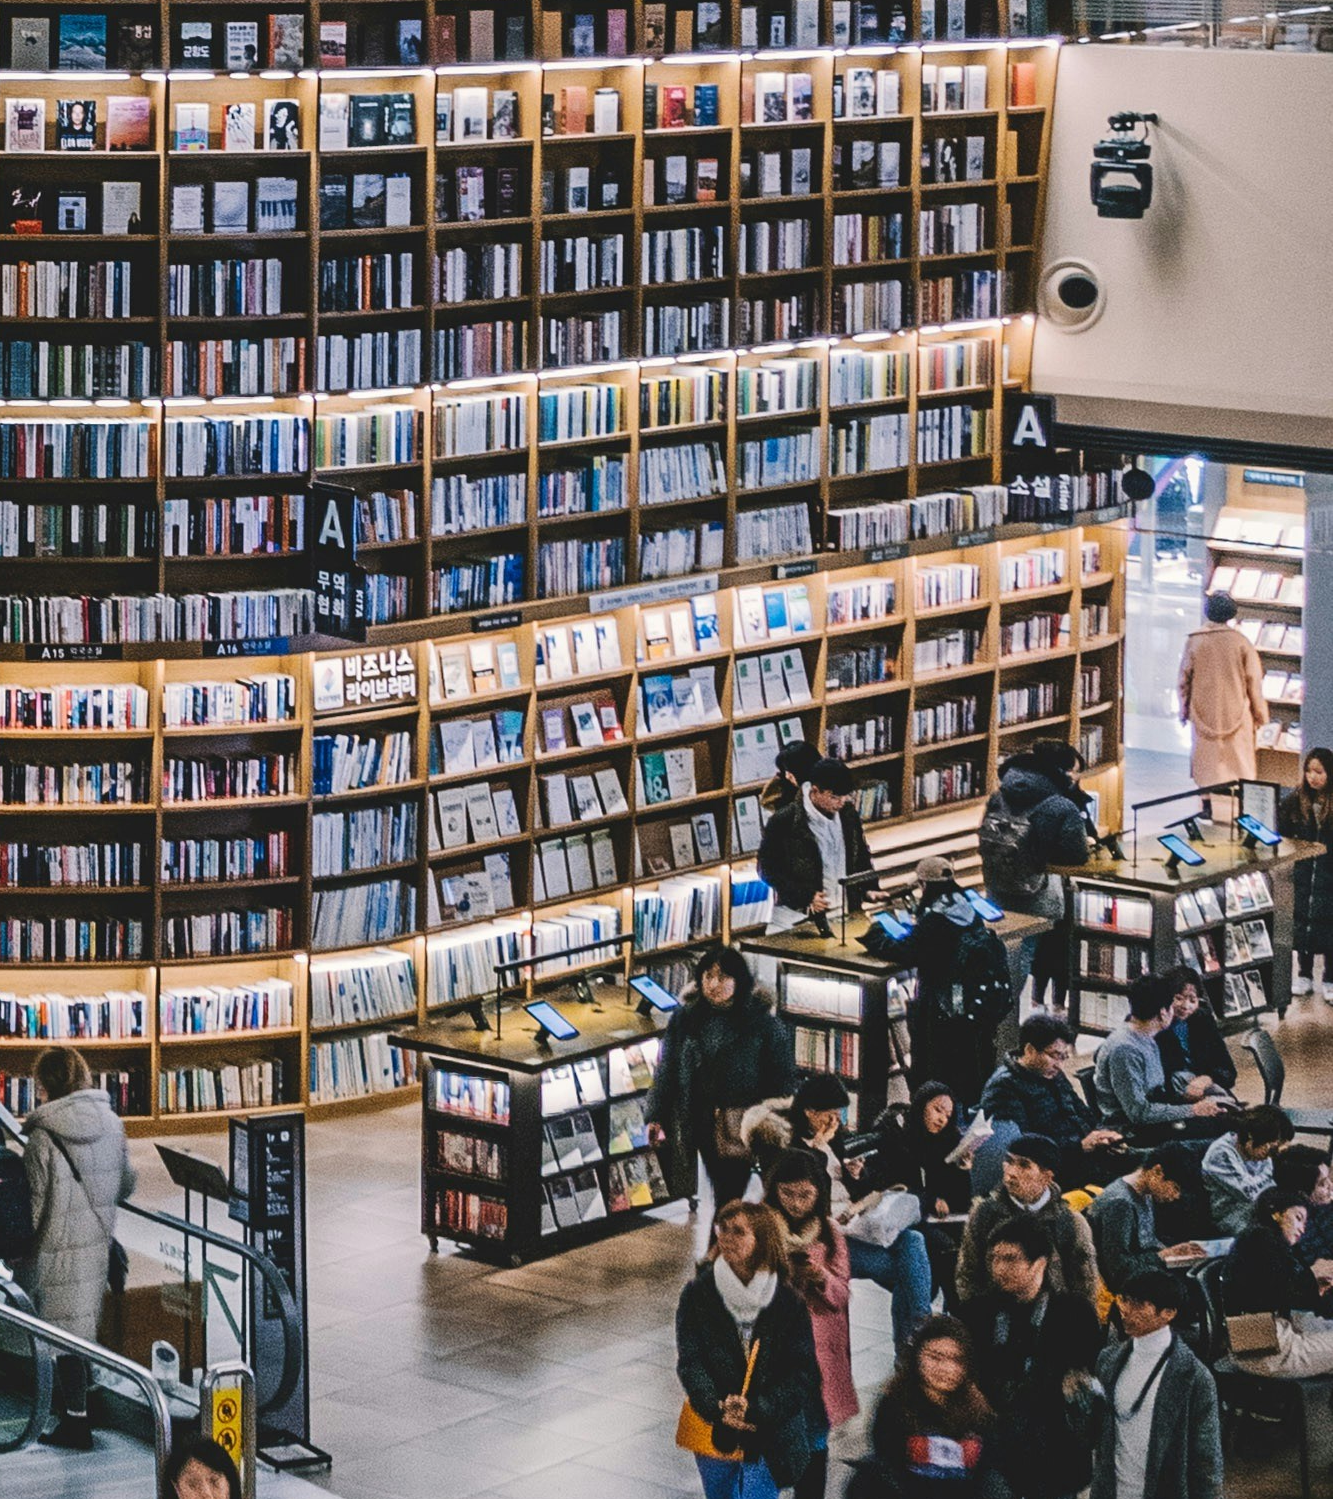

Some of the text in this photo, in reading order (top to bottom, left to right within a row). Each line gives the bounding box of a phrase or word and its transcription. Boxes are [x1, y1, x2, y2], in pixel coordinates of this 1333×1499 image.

[1012, 405, 1046, 448] A
[1010, 474, 1050, 499] 소설
[319, 500, 345, 549] A
[41, 647, 64, 659] A15
[216, 643, 238, 655] A16
[345, 648, 414, 682] 비즈니스
[346, 673, 416, 706] 라이브러리
